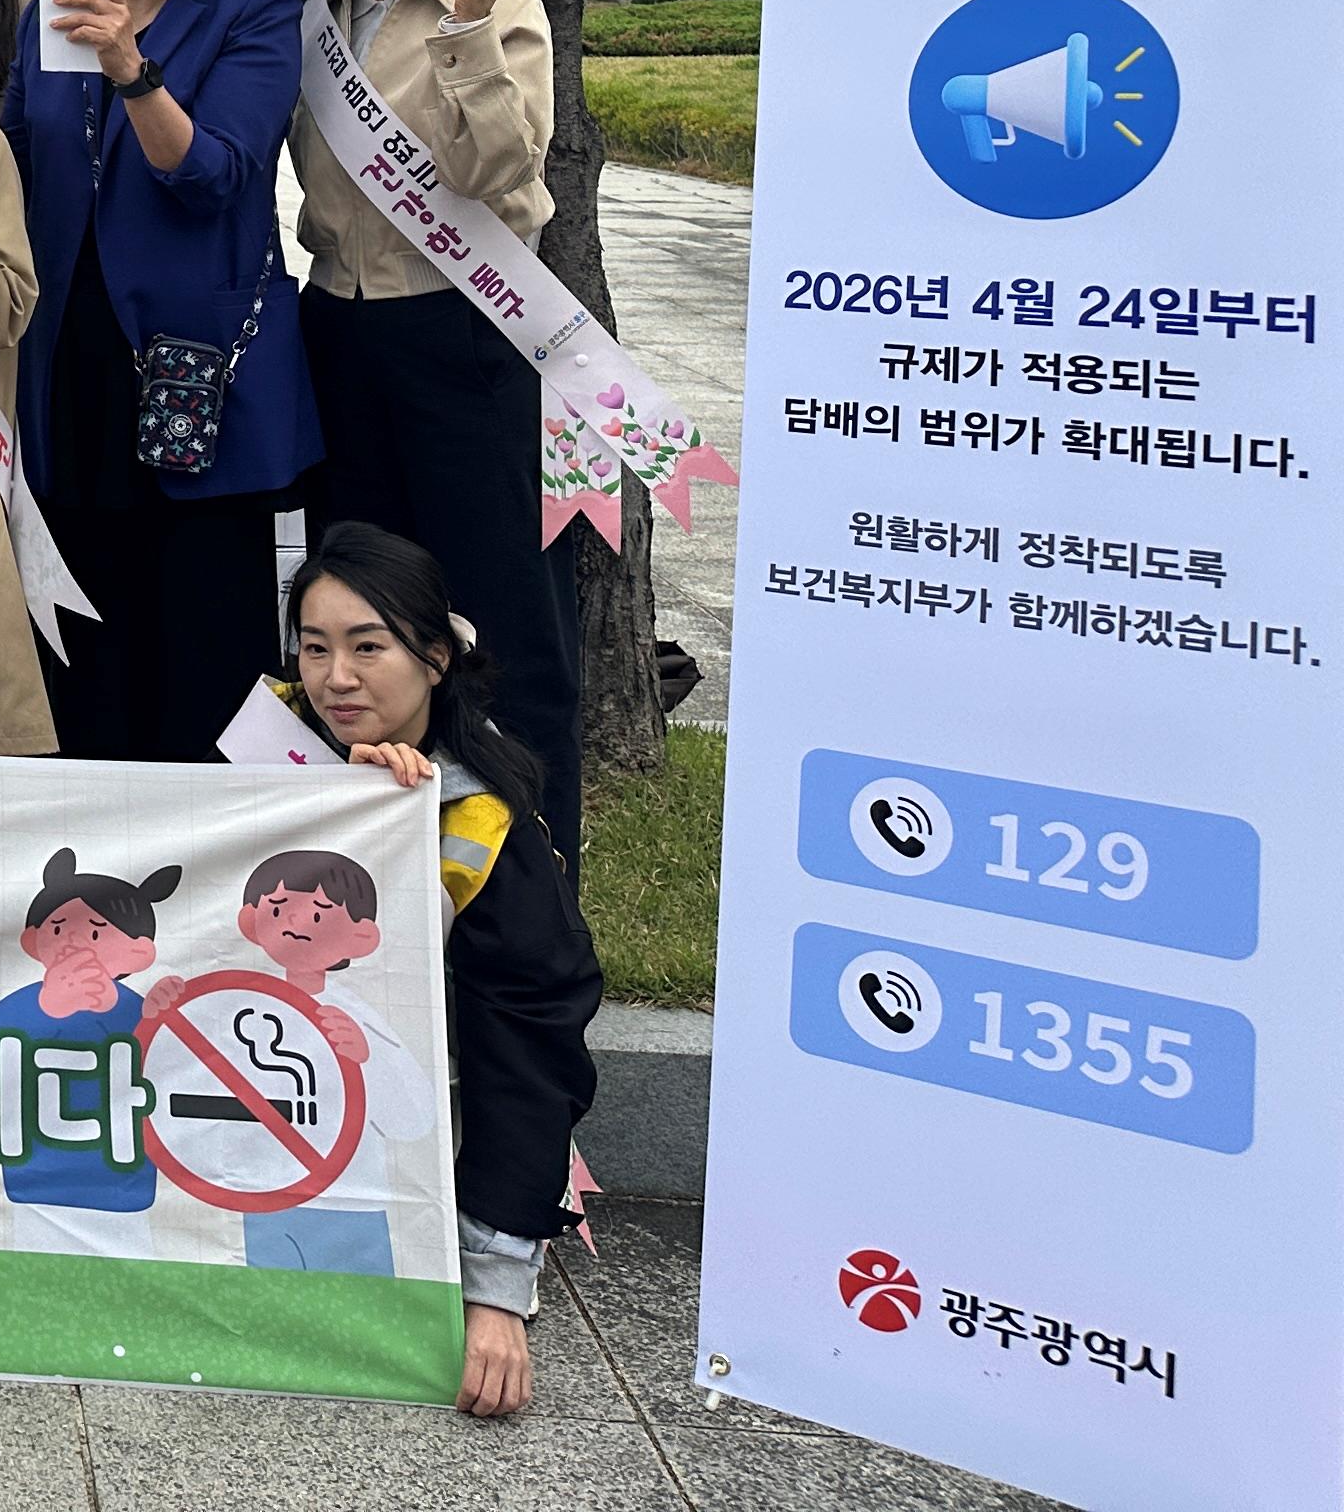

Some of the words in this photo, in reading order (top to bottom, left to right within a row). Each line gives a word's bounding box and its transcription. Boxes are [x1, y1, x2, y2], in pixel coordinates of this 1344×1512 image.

[317, 24, 348, 76] 간접
[341, 75, 388, 133] 흡연
[384, 129, 439, 192] 없는
[360, 153, 471, 262] 건강한
[468, 263, 526, 319] 동구
[784, 270, 950, 321] 2026년
[971, 279, 1055, 327] 4월
[1077, 284, 1316, 344] 24일부터
[879, 343, 1004, 387] 규제가
[1020, 351, 1199, 402] 적용되는
[783, 397, 901, 442] 담배의
[919, 408, 1045, 454] 범위가
[1061, 419, 1309, 479] 확대됩니다.
[849, 512, 1000, 563] 원활하게
[1018, 530, 1227, 588] 정착되도록
[764, 563, 993, 623] 보건복지부가
[1008, 592, 1321, 667] 함께하겠습니다.
[985, 812, 1149, 901] 129
[968, 989, 1194, 1100] 1355
[939, 1287, 1177, 1400] 광주광역시
